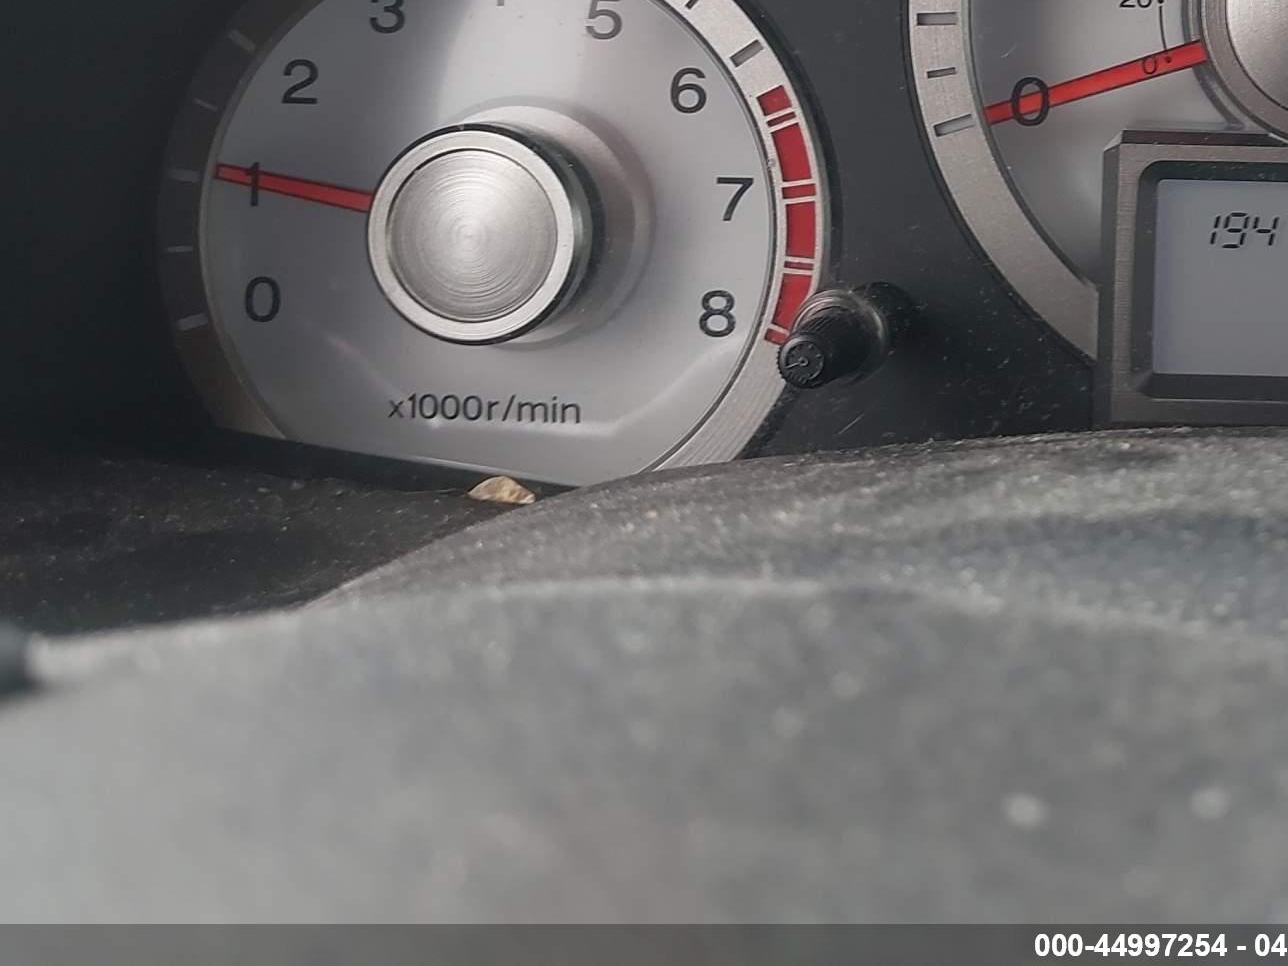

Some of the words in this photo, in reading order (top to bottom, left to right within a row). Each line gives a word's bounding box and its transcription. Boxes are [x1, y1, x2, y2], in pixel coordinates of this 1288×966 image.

[282, 59, 318, 104] 2
[1142, 57, 1157, 75] 0
[670, 67, 707, 114] 6
[1011, 77, 1049, 126] 0
[244, 162, 260, 206] 1
[716, 177, 754, 222] 7
[244, 277, 280, 322] 0
[699, 290, 736, 336] 8
[387, 392, 581, 424] x1000r/min
